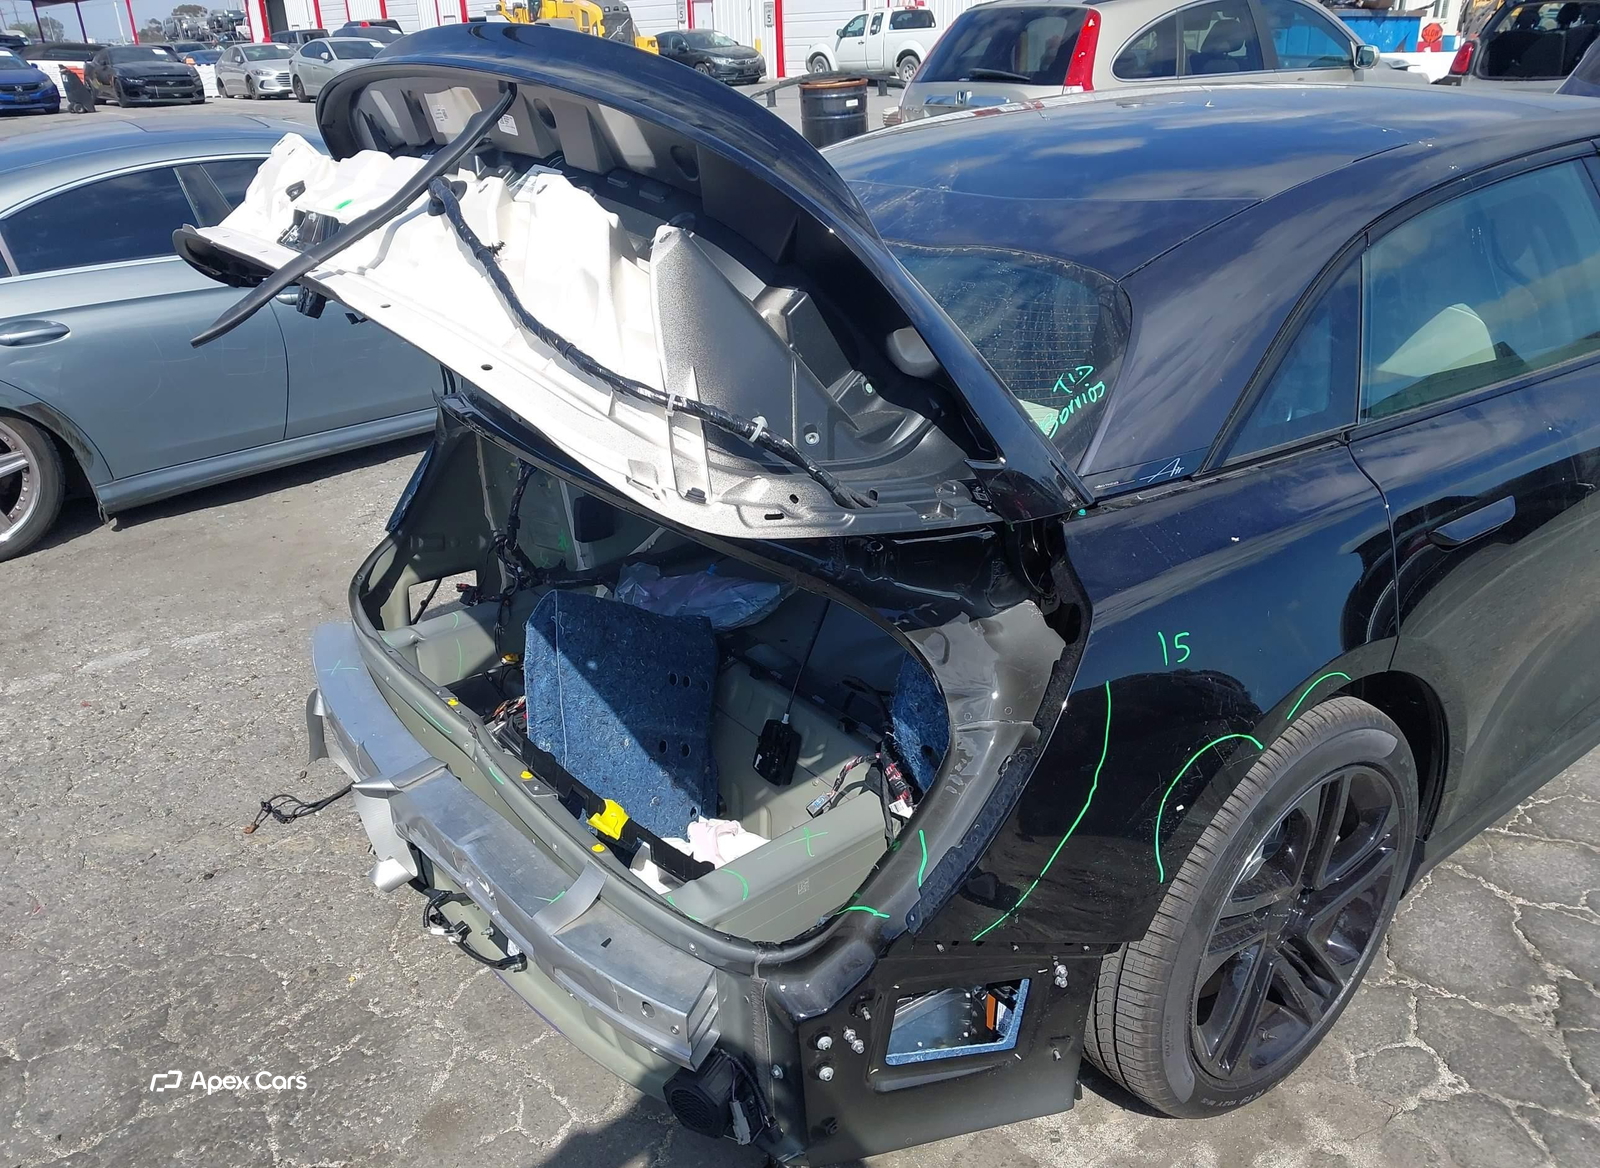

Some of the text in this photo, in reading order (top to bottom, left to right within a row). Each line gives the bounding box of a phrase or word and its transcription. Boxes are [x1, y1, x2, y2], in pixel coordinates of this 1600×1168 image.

[766, 14, 772, 23] 5
[1139, 458, 1185, 483] Air
[1157, 631, 1191, 667] 15
